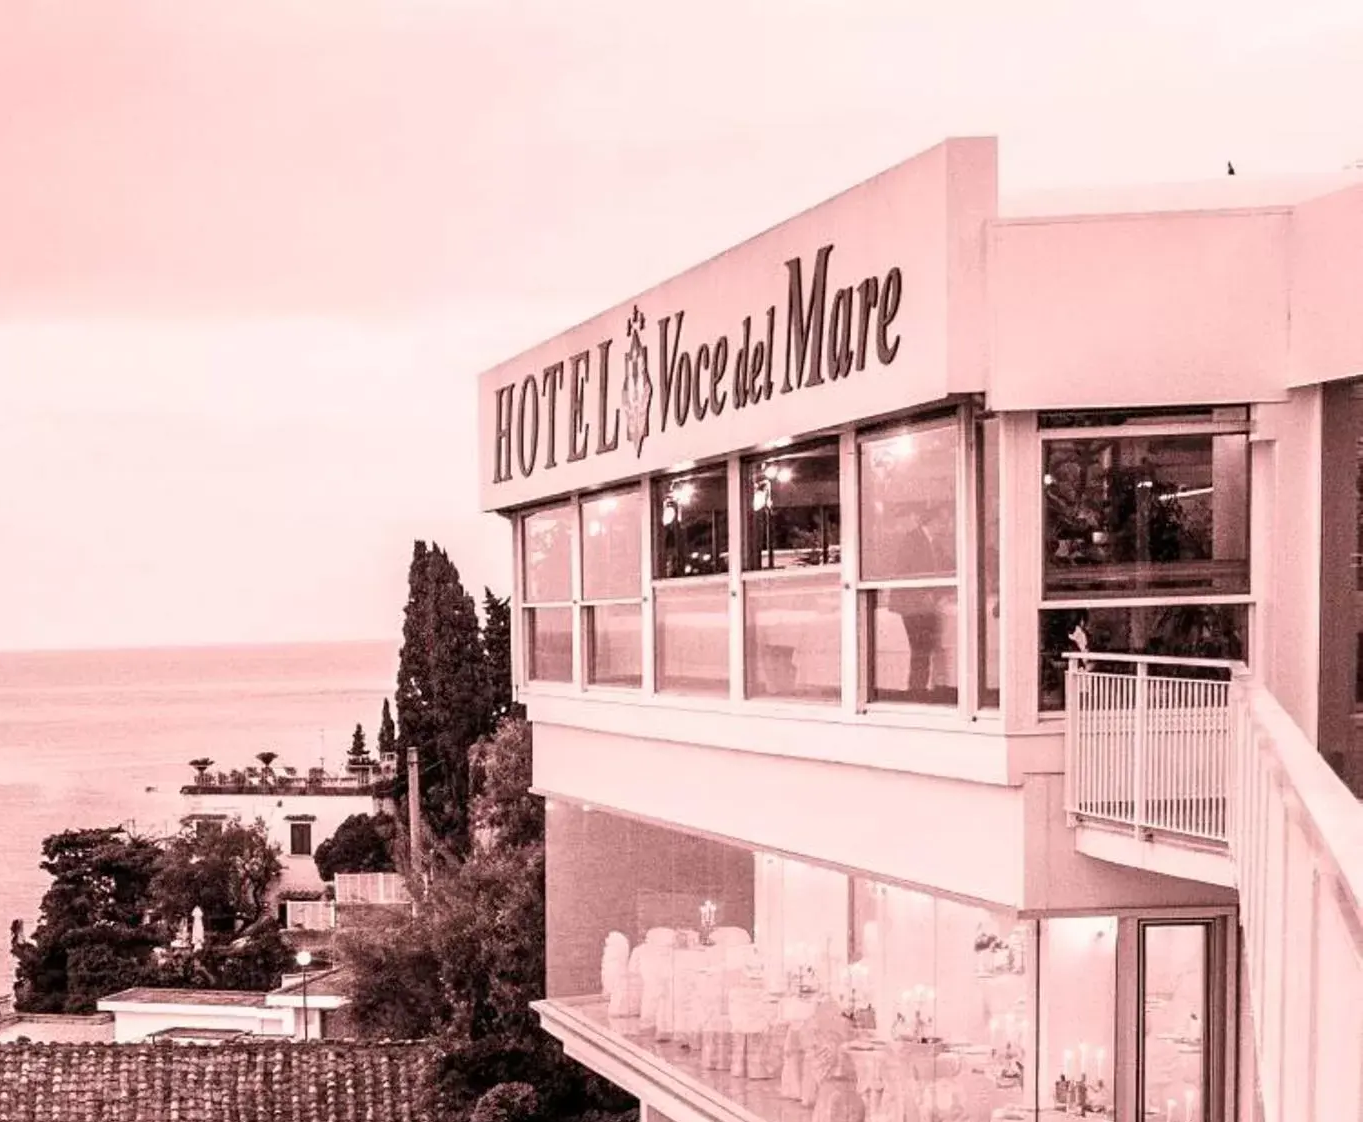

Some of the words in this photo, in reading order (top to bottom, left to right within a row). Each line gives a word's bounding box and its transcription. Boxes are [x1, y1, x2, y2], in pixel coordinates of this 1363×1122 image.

[493, 339, 620, 484] HOTEL
[658, 310, 728, 432] Voce
[733, 305, 776, 409] del
[780, 244, 902, 394] Mare
